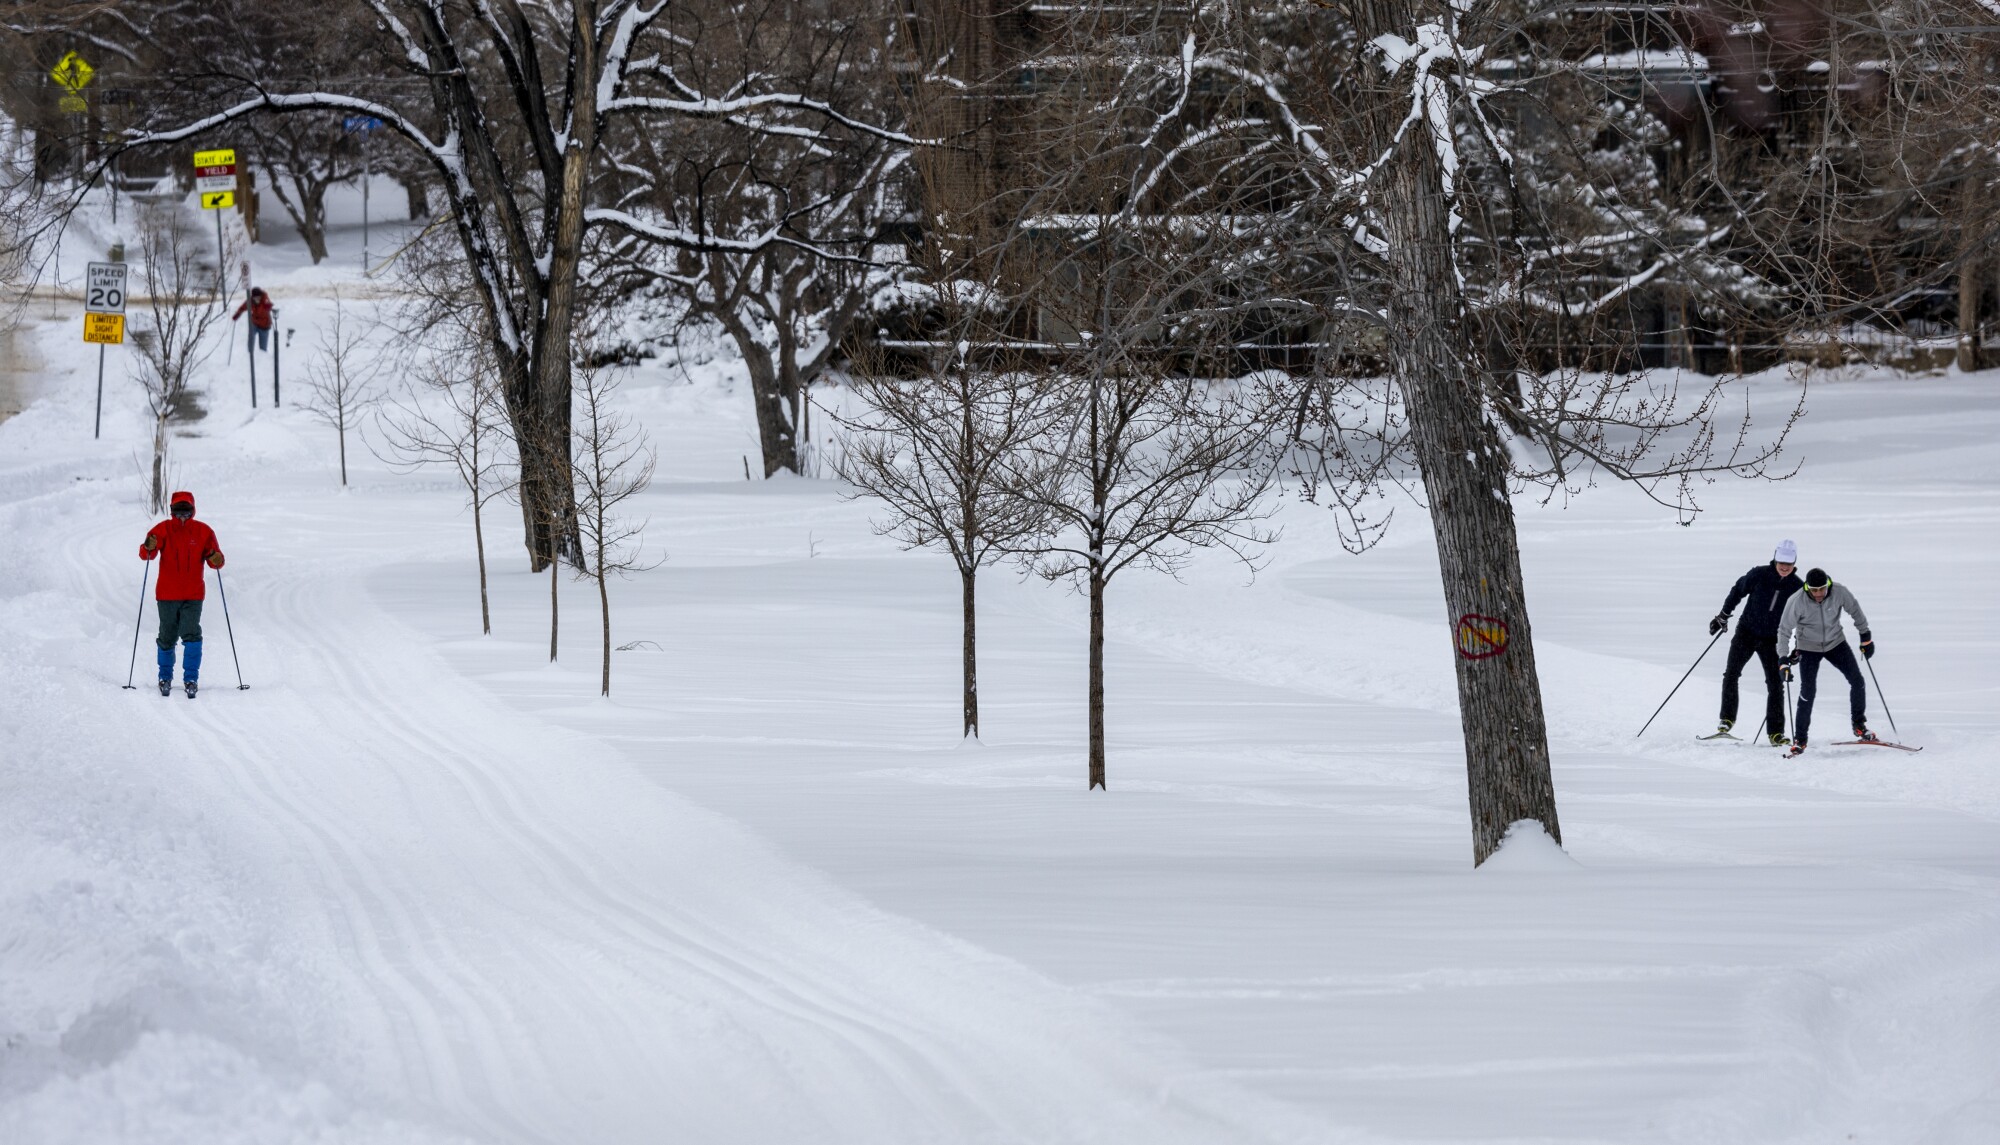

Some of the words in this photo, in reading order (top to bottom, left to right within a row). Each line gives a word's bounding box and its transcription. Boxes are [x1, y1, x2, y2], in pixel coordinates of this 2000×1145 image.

[205, 166, 228, 175] YIELD
[91, 267, 124, 278] SPEED
[94, 278, 119, 287] LIMIT
[90, 288, 122, 307] 20
[92, 315, 118, 324] LIMITED
[94, 324, 114, 333] SIGHT
[87, 333, 118, 342] DISTANCE
